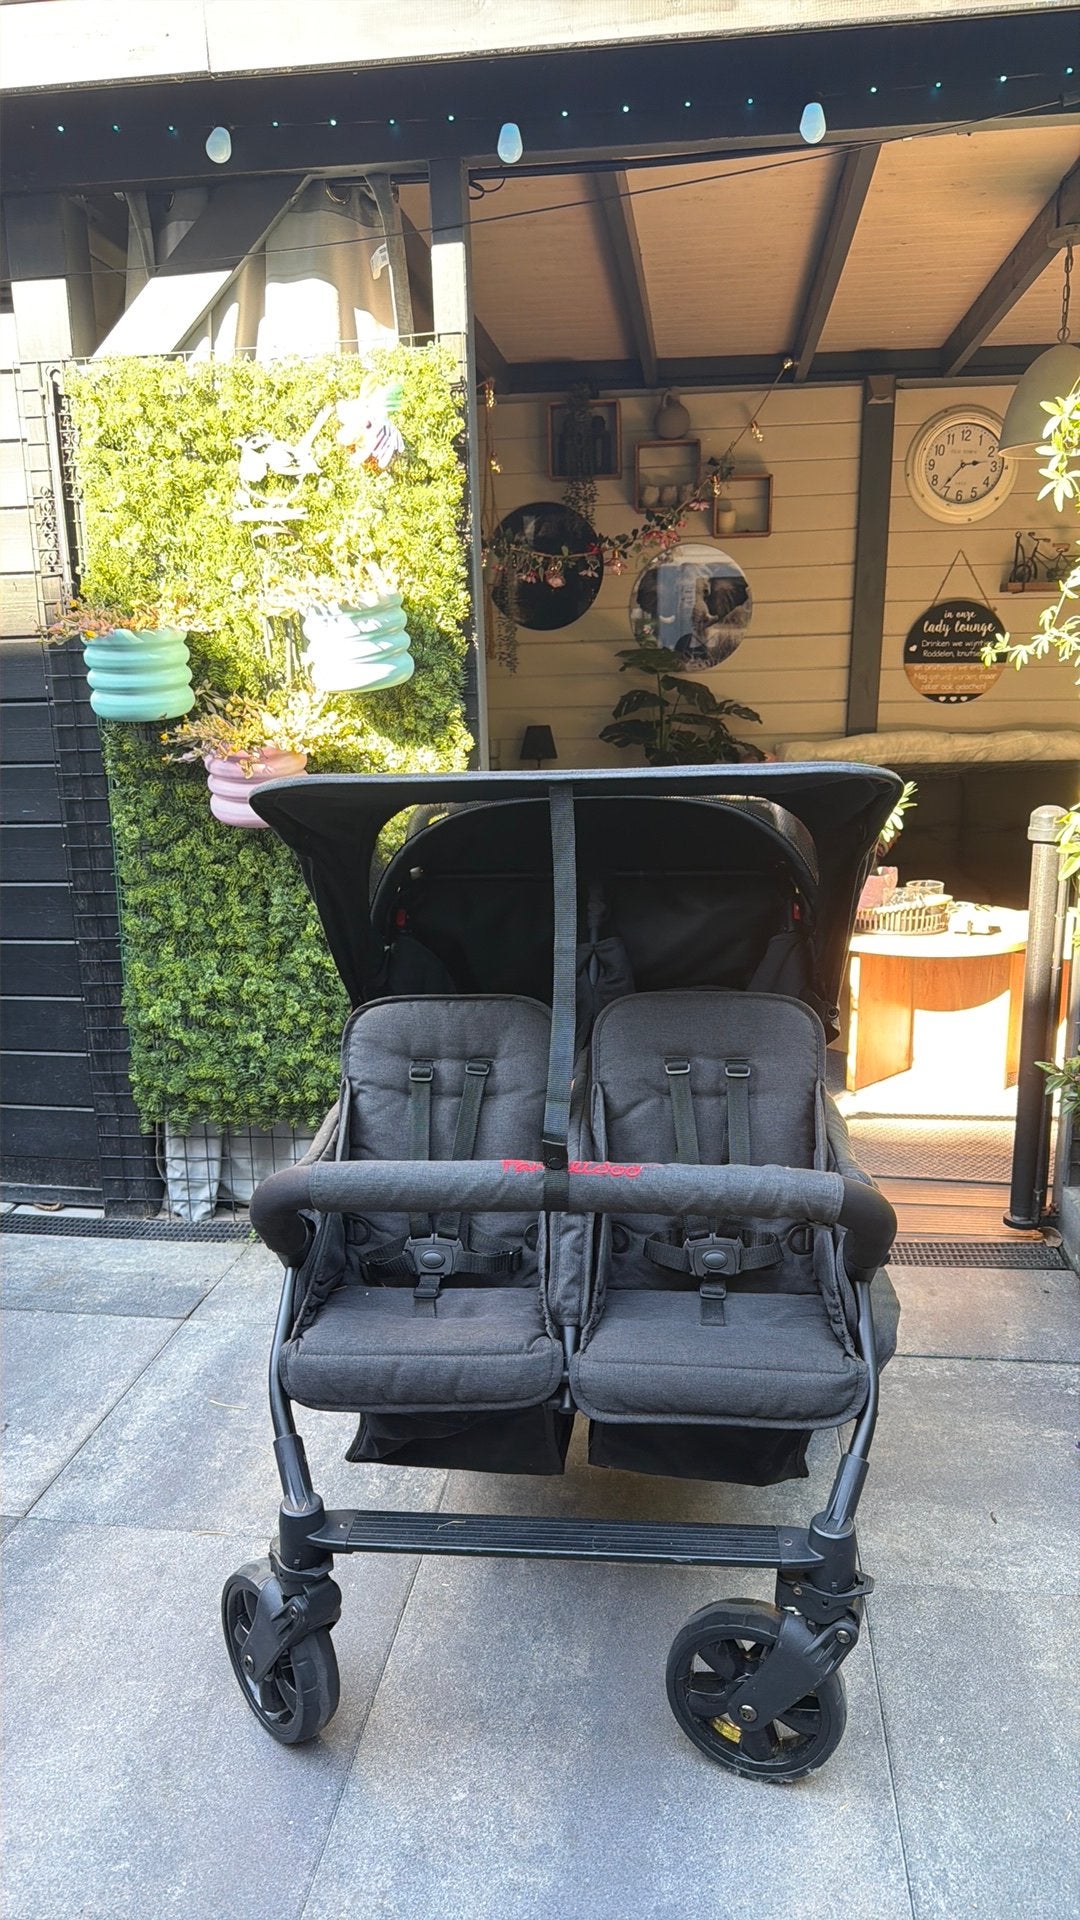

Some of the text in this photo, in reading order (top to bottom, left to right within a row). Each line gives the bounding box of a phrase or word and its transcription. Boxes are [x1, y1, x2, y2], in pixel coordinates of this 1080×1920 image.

[947, 433, 955, 445] 11
[961, 429, 972, 441] 12
[979, 434, 983, 446] 1
[935, 444, 945, 456] 10
[987, 446, 996, 458] 2
[928, 459, 935, 471] 9
[990, 461, 997, 472] 3
[931, 474, 938, 486] 8
[983, 476, 990, 487] 4
[943, 486, 950, 497] 7
[956, 490, 963, 501] 6
[970, 487, 977, 499] 5
[944, 610, 976, 621] in onze
[923, 620, 995, 637] lady lounge
